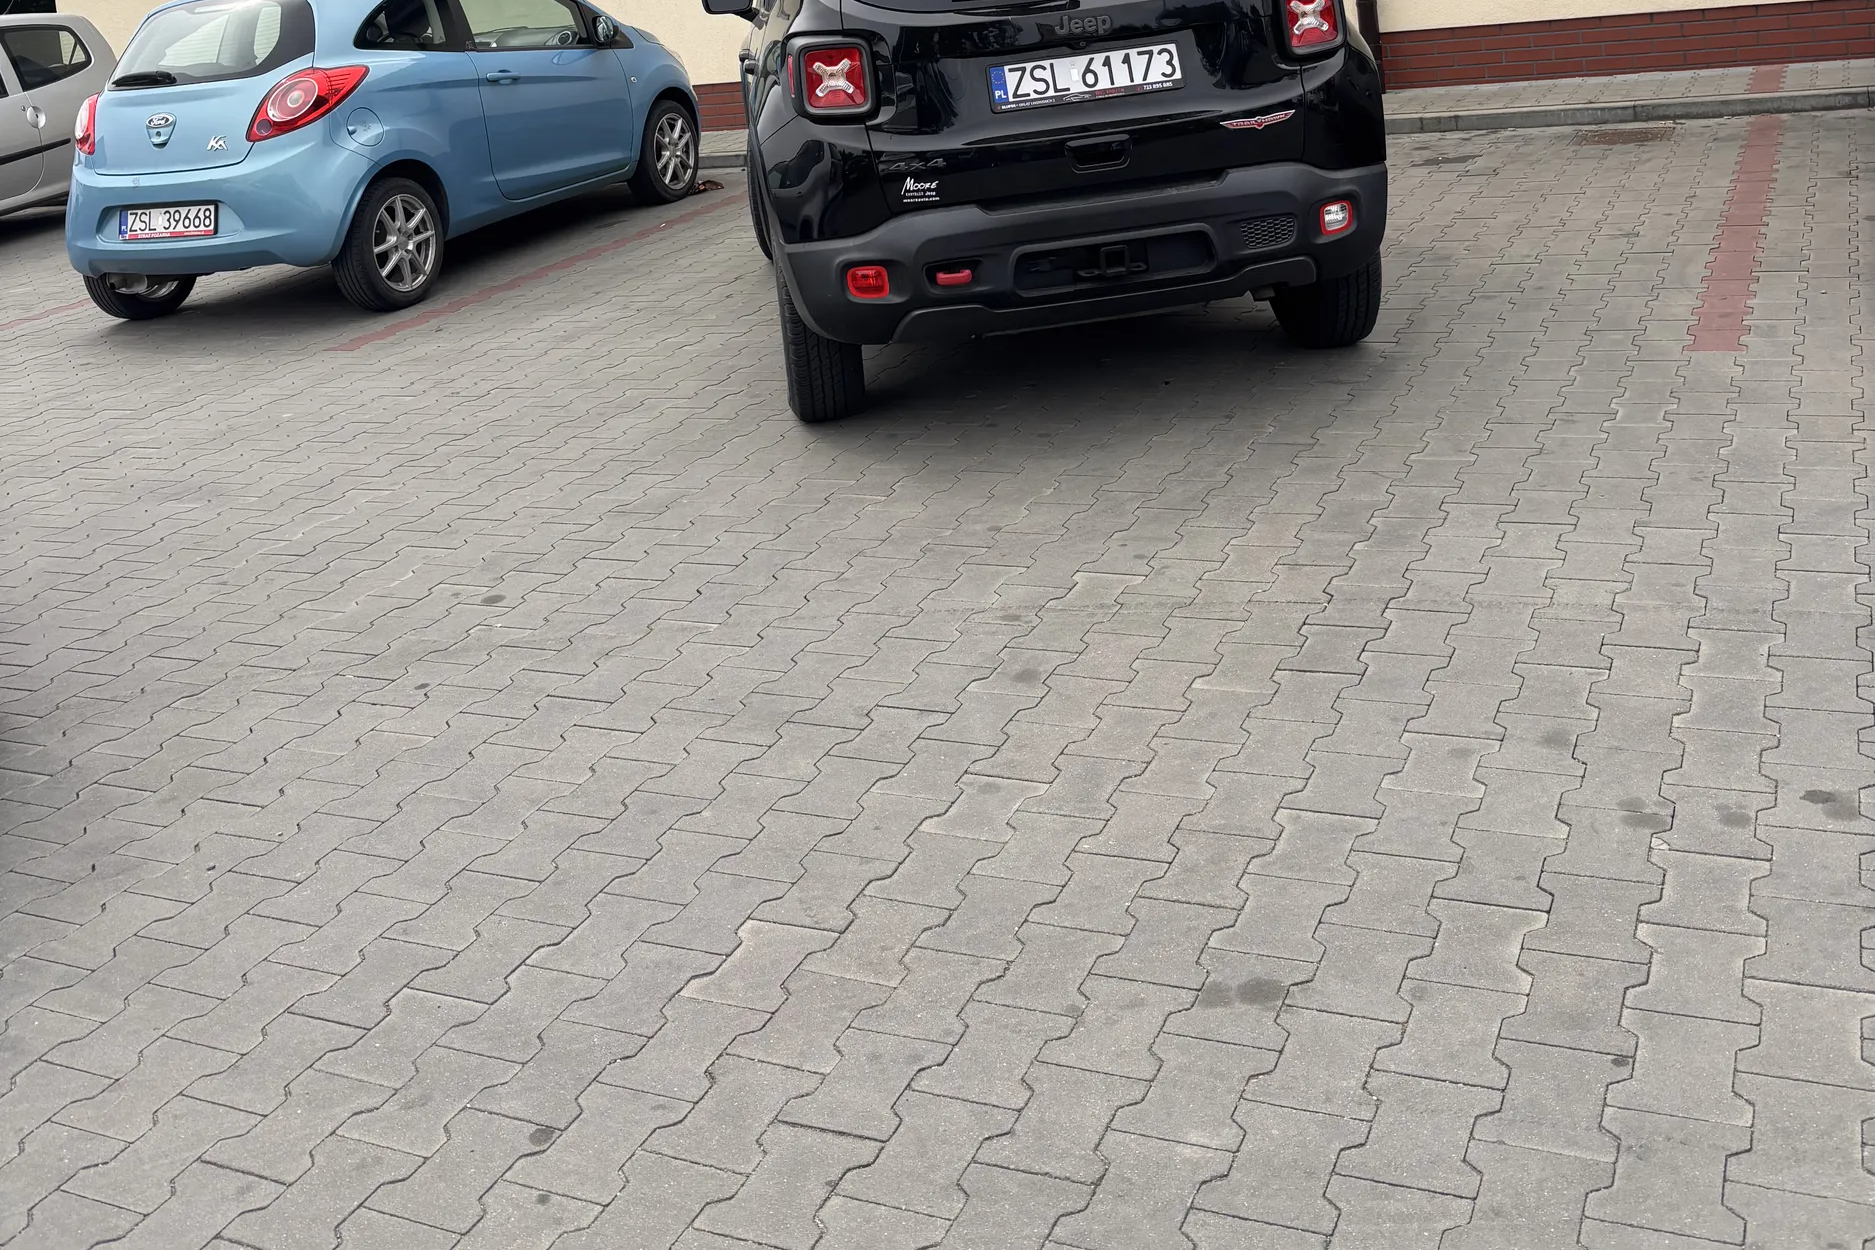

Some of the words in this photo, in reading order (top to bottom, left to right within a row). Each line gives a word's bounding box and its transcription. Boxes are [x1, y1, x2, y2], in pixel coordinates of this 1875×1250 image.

[1055, 15, 1111, 35] Jeep
[1008, 62, 1071, 99] ZSL
[1081, 48, 1176, 89] 61173
[994, 90, 1007, 100] PL
[150, 116, 167, 126] Ford
[129, 211, 157, 233] ZSL
[163, 207, 212, 230] 39668
